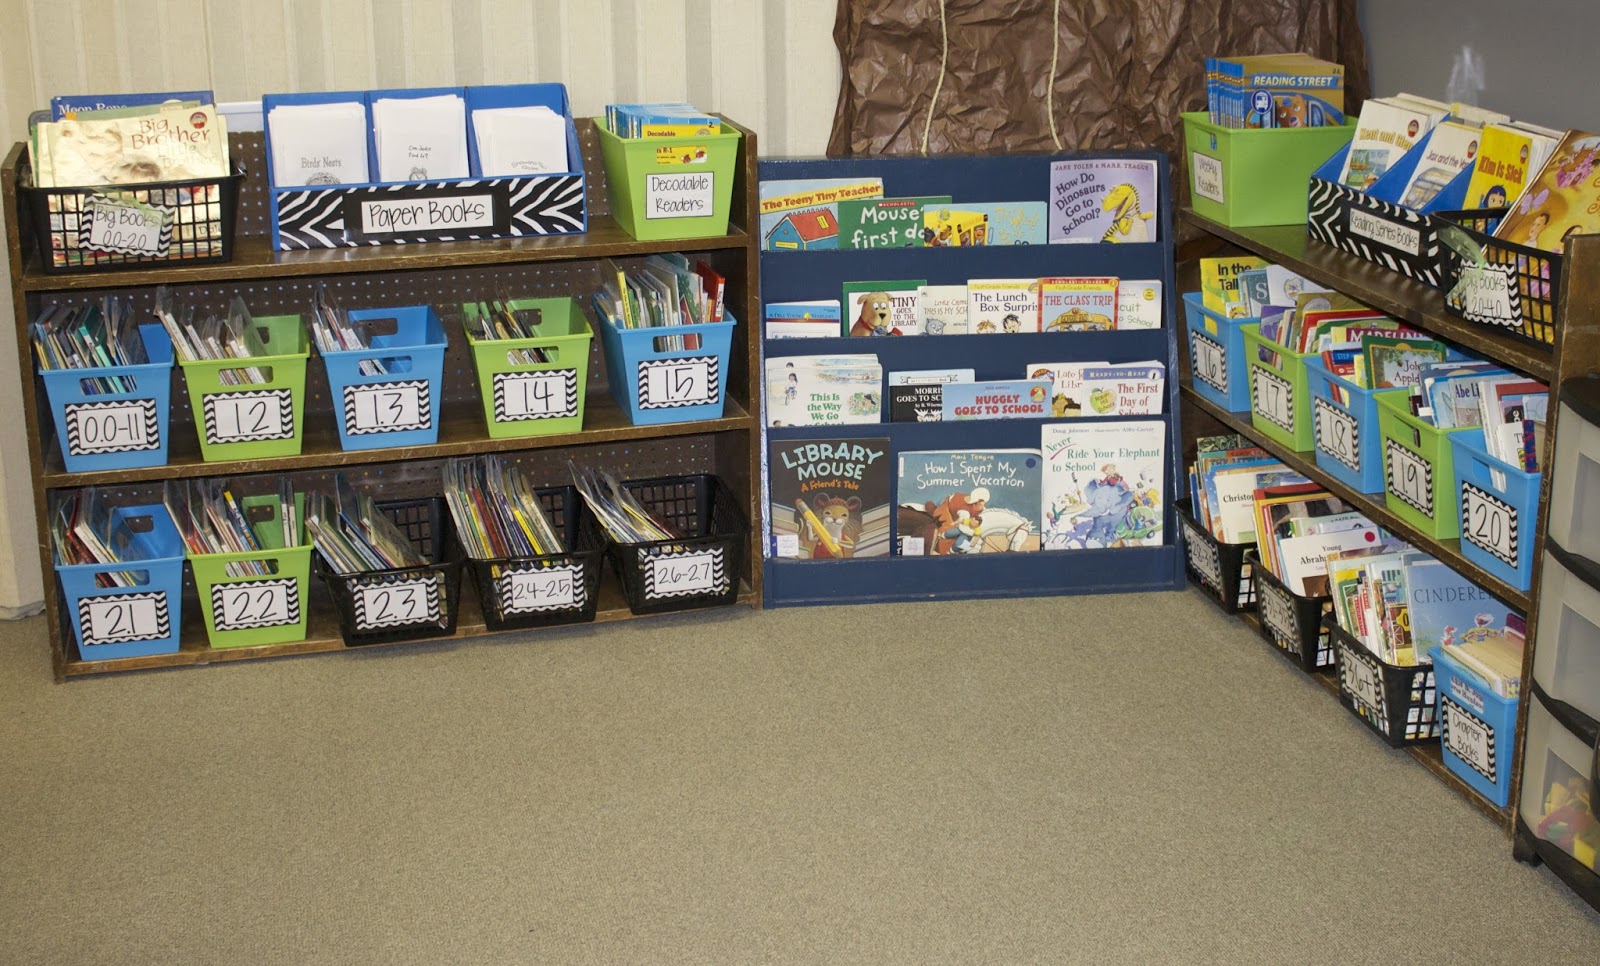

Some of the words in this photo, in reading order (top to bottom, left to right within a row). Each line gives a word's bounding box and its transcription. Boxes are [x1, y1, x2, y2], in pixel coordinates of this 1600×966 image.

[1254, 76, 1295, 86] READING
[1298, 76, 1333, 86] STREET
[139, 118, 169, 134] Big
[131, 126, 210, 150] Brother
[1379, 131, 1396, 144] and
[300, 157, 321, 169] Birds
[323, 156, 341, 168] Nests
[1439, 154, 1451, 165] and
[1451, 156, 1459, 167] the
[1478, 156, 1496, 176] Kim
[1506, 163, 1523, 184] Sick
[652, 175, 709, 192] Decodable
[1055, 178, 1078, 196] How
[1080, 172, 1095, 184] Do
[655, 198, 704, 212] Readers
[762, 201, 783, 211] The
[784, 194, 814, 207] Teeny
[815, 191, 837, 204] Tiny
[839, 184, 881, 198] Teacher
[1055, 183, 1106, 211] Dinosaurs
[369, 203, 423, 232] Paper
[429, 198, 485, 226] Books
[1065, 204, 1081, 217] Go
[1082, 198, 1094, 209] to
[96, 205, 115, 229] Big
[120, 208, 159, 227] Books
[1062, 207, 1101, 235] School?
[1351, 211, 1375, 239] Reading
[1376, 219, 1396, 241] Series
[1397, 229, 1418, 248] Books
[851, 227, 898, 249] first
[1218, 263, 1228, 276] In
[1218, 278, 1238, 291] Tall
[1480, 272, 1506, 291] Books
[891, 297, 917, 307] TINY
[973, 292, 992, 302] The
[996, 292, 1027, 302] Lunch
[1045, 296, 1062, 306] THE
[1064, 295, 1090, 306] CLASS
[1093, 295, 1113, 306] TRIP
[945, 306, 953, 315] MY
[980, 303, 1000, 312] Box
[1127, 315, 1154, 328] School
[1350, 329, 1423, 342] MADELIN
[1057, 370, 1076, 379] Late
[665, 368, 694, 400] 1.5
[1118, 383, 1134, 394] The
[1137, 383, 1158, 393] First
[1455, 384, 1470, 399] Abe
[523, 381, 554, 412] 1.4
[810, 393, 830, 402] This
[832, 393, 840, 401] Is
[976, 394, 1020, 405] HUGGLY
[1120, 396, 1137, 408] Day
[1140, 396, 1149, 406] of
[1265, 379, 1280, 417] 1.7
[372, 394, 403, 425] 1.3
[807, 403, 823, 411] the
[825, 403, 842, 412] Way
[955, 406, 982, 416] GOES
[985, 405, 999, 415] TO
[1002, 404, 1043, 414] SCHOOL
[234, 401, 269, 435] 1.2
[811, 413, 825, 421] We
[827, 412, 839, 420] Go
[1329, 415, 1348, 456] 1.8
[1046, 437, 1071, 453] Never
[781, 442, 884, 469] LIBRARY
[1067, 449, 1089, 459] Ride
[1093, 449, 1115, 459] Your
[1119, 448, 1160, 460] Elephant
[797, 462, 866, 480] MOUSE
[925, 462, 947, 475] How
[950, 462, 955, 473] I
[960, 461, 992, 476] Spent
[998, 462, 1017, 477] My
[1052, 464, 1062, 472] to
[1065, 462, 1096, 472] School
[801, 483, 809, 492] A
[809, 479, 841, 490] Friend's
[843, 480, 859, 490] Tale
[917, 474, 965, 490] Summer
[972, 475, 1025, 487] Vacation
[1400, 457, 1420, 501] 1.9
[1475, 503, 1502, 547] 2.0
[232, 590, 278, 622] 2.2
[373, 589, 416, 621] 2.3
[105, 604, 135, 636] 2.1
[1452, 713, 1481, 743] Chapter
[1457, 736, 1479, 760] Books
